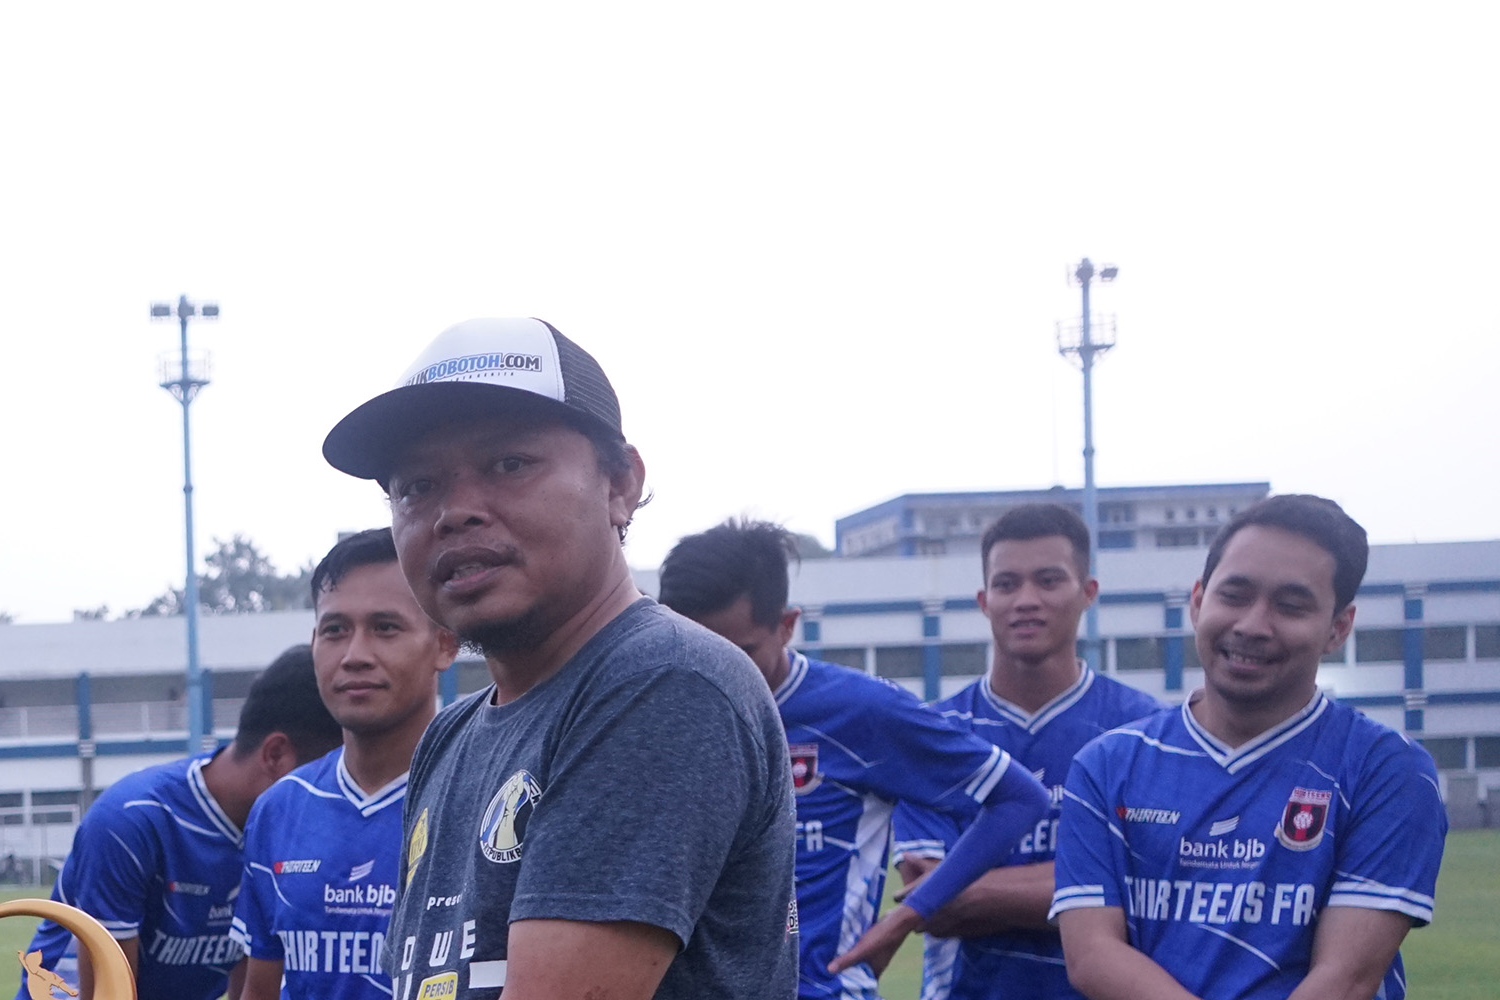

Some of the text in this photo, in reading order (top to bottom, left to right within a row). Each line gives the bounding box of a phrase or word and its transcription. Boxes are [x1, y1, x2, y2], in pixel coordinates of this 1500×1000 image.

[1179, 836, 1266, 861] bank bjb
[324, 884, 396, 907] bank bjb
[422, 979, 455, 999] PERSIB
